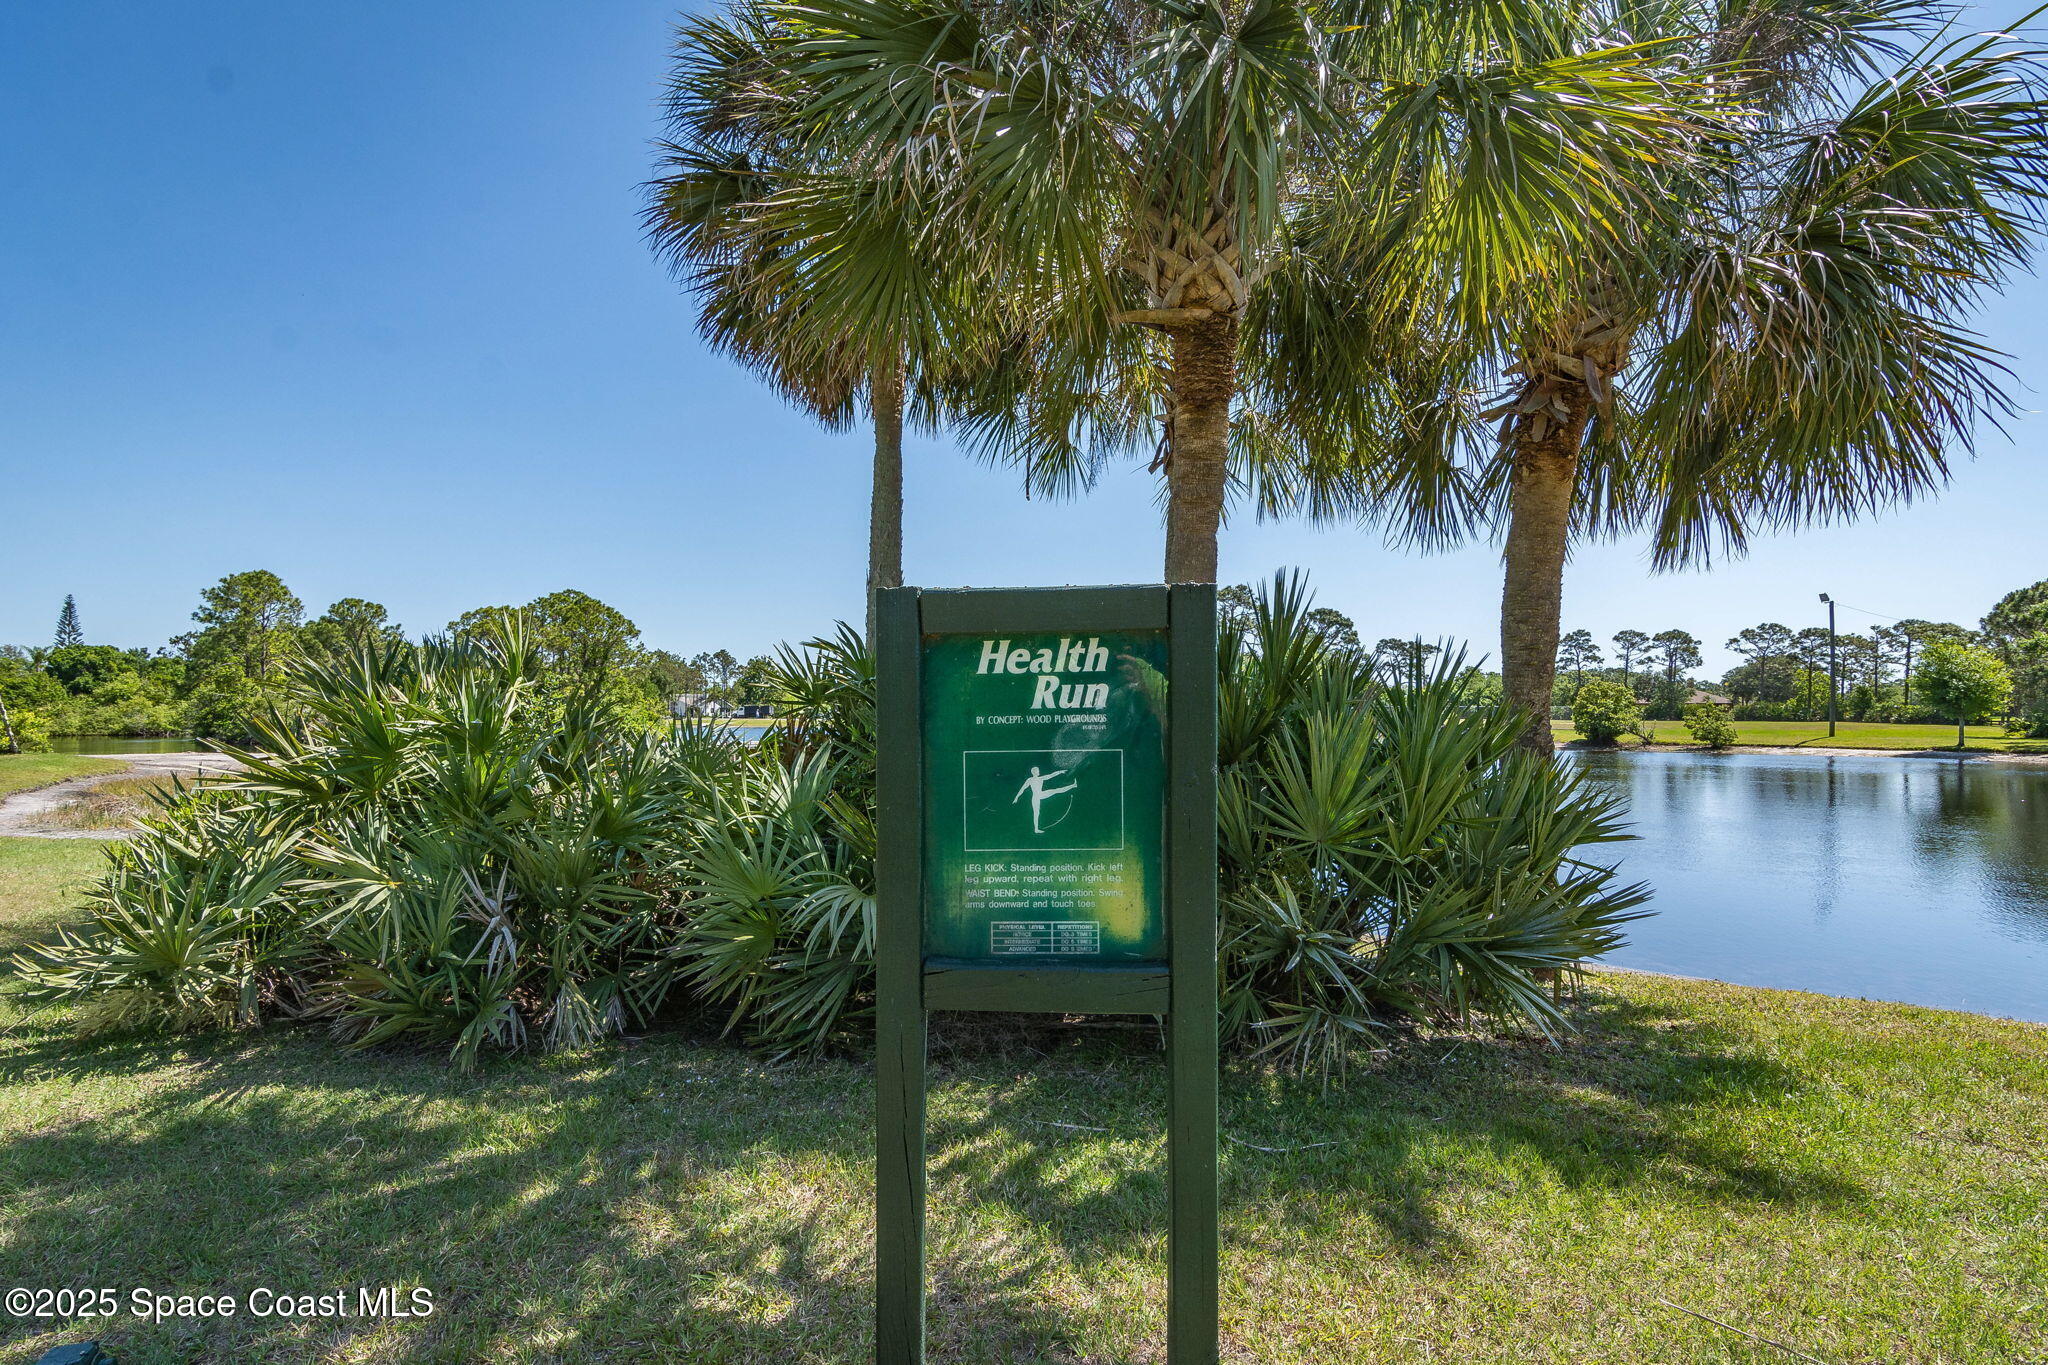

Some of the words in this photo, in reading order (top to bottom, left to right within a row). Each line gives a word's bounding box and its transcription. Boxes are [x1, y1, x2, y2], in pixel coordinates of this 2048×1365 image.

[976, 637, 1109, 674] Health
[1030, 675, 1109, 710] Run
[976, 716, 984, 725] BY
[988, 715, 1023, 725] CONCEPT:
[1026, 715, 1051, 724] WOOD
[1054, 713, 1107, 724] PLAYGROUNDS
[964, 864, 981, 872] LEG
[984, 863, 1007, 872] KICK:
[1010, 863, 1047, 874] Standing
[1050, 863, 1085, 874] position.
[1088, 862, 1106, 871] Kick
[1110, 862, 1123, 871] left
[964, 875, 979, 885] leg
[983, 874, 1019, 884] upward,
[1023, 874, 1053, 884] repeat
[1058, 874, 1077, 882] with
[1082, 874, 1102, 884] right
[966, 889, 990, 898] WAIST
[1022, 888, 1058, 898] Standing
[1061, 887, 1095, 898] position.
[988, 899, 1029, 908] downward
[1032, 899, 1048, 908] and
[1052, 899, 1074, 908] touch
